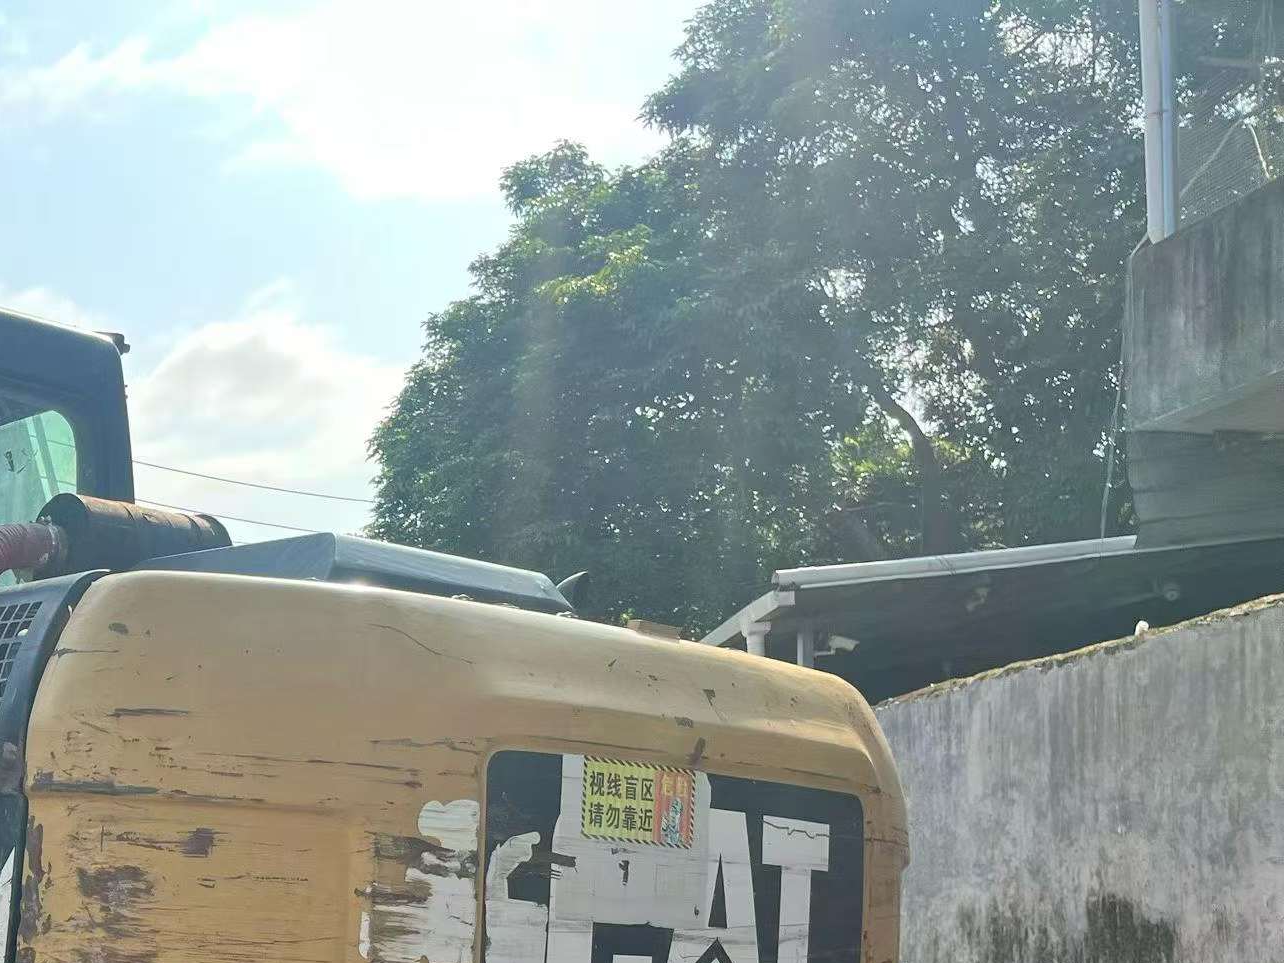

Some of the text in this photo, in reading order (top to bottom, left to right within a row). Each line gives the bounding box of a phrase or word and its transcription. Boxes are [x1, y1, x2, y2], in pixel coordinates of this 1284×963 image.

[589, 771, 654, 802] 视线盲区
[588, 802, 653, 832] 请勿靠近
